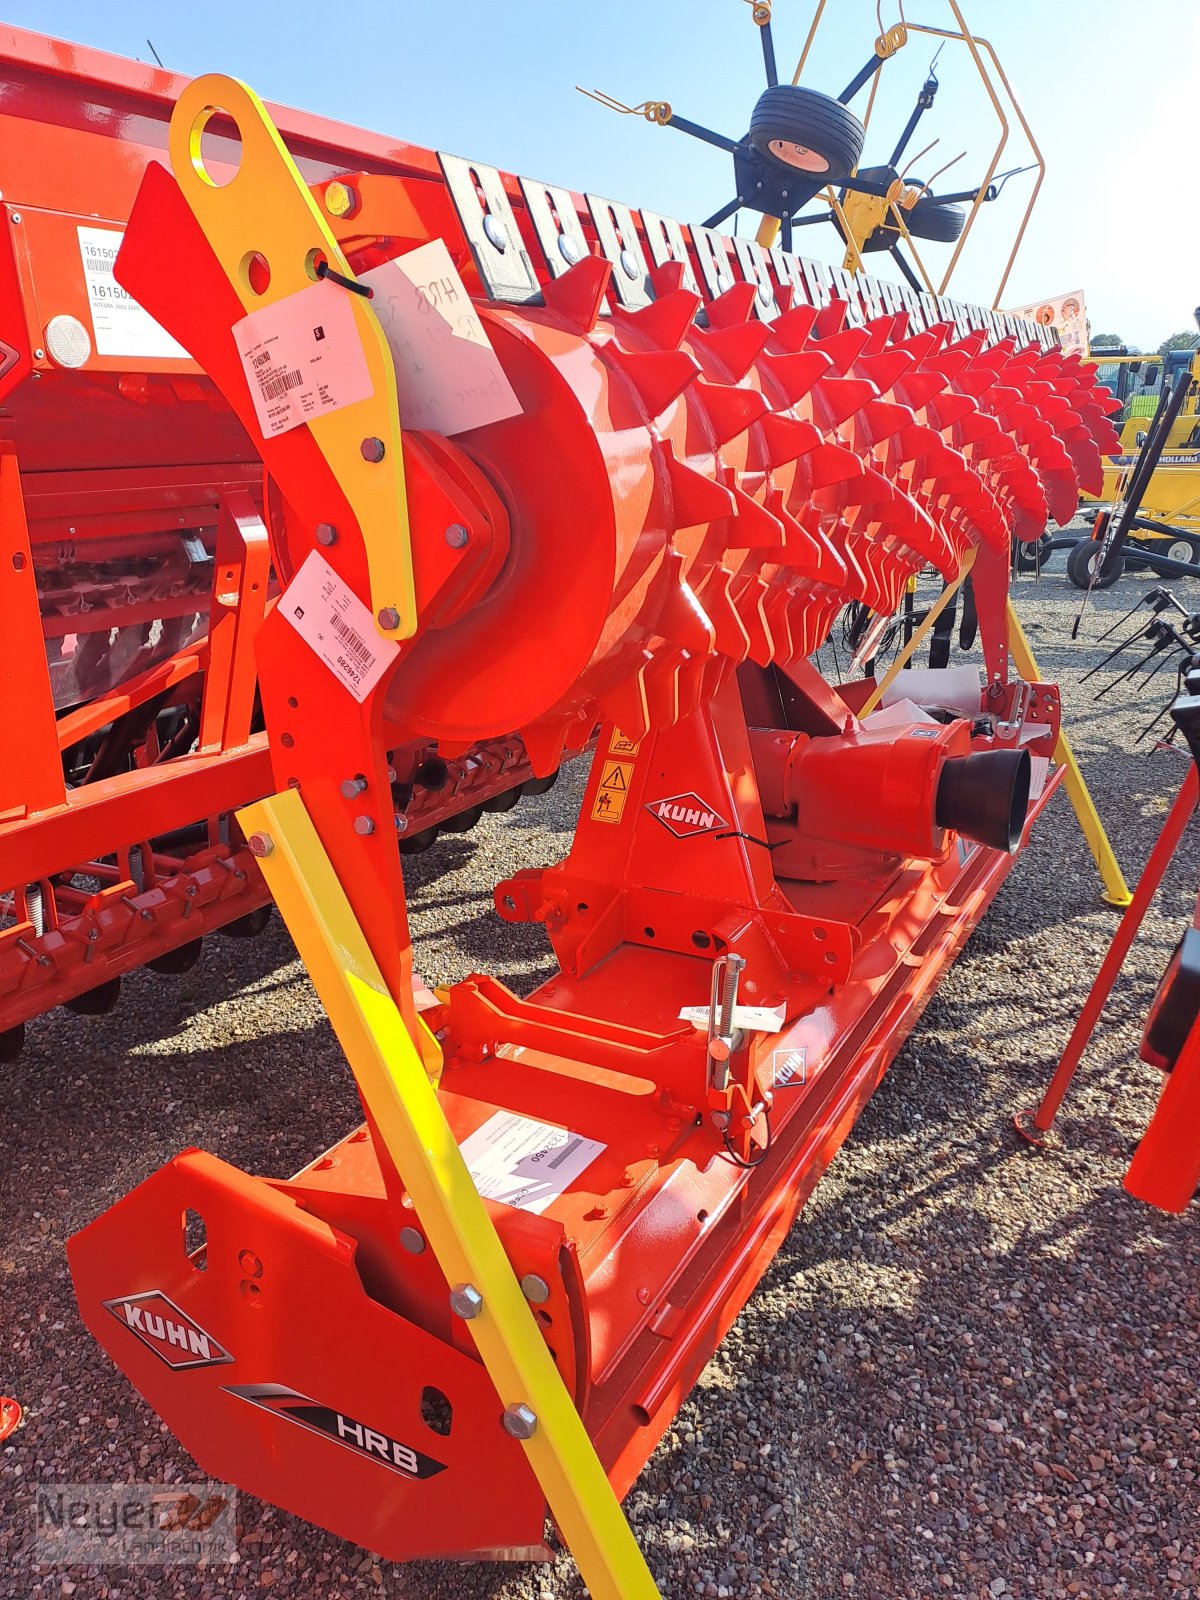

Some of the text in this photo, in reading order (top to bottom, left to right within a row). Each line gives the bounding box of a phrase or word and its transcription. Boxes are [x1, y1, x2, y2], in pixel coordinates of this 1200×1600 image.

[1159, 455, 1198, 463] HOLLAND
[337, 656, 362, 685] 1246280
[658, 802, 715, 828] KUHN
[775, 1051, 804, 1085] KUHN
[531, 1133, 566, 1163] 1232450
[123, 1302, 211, 1360] KUHN
[336, 1413, 418, 1474] HRB
